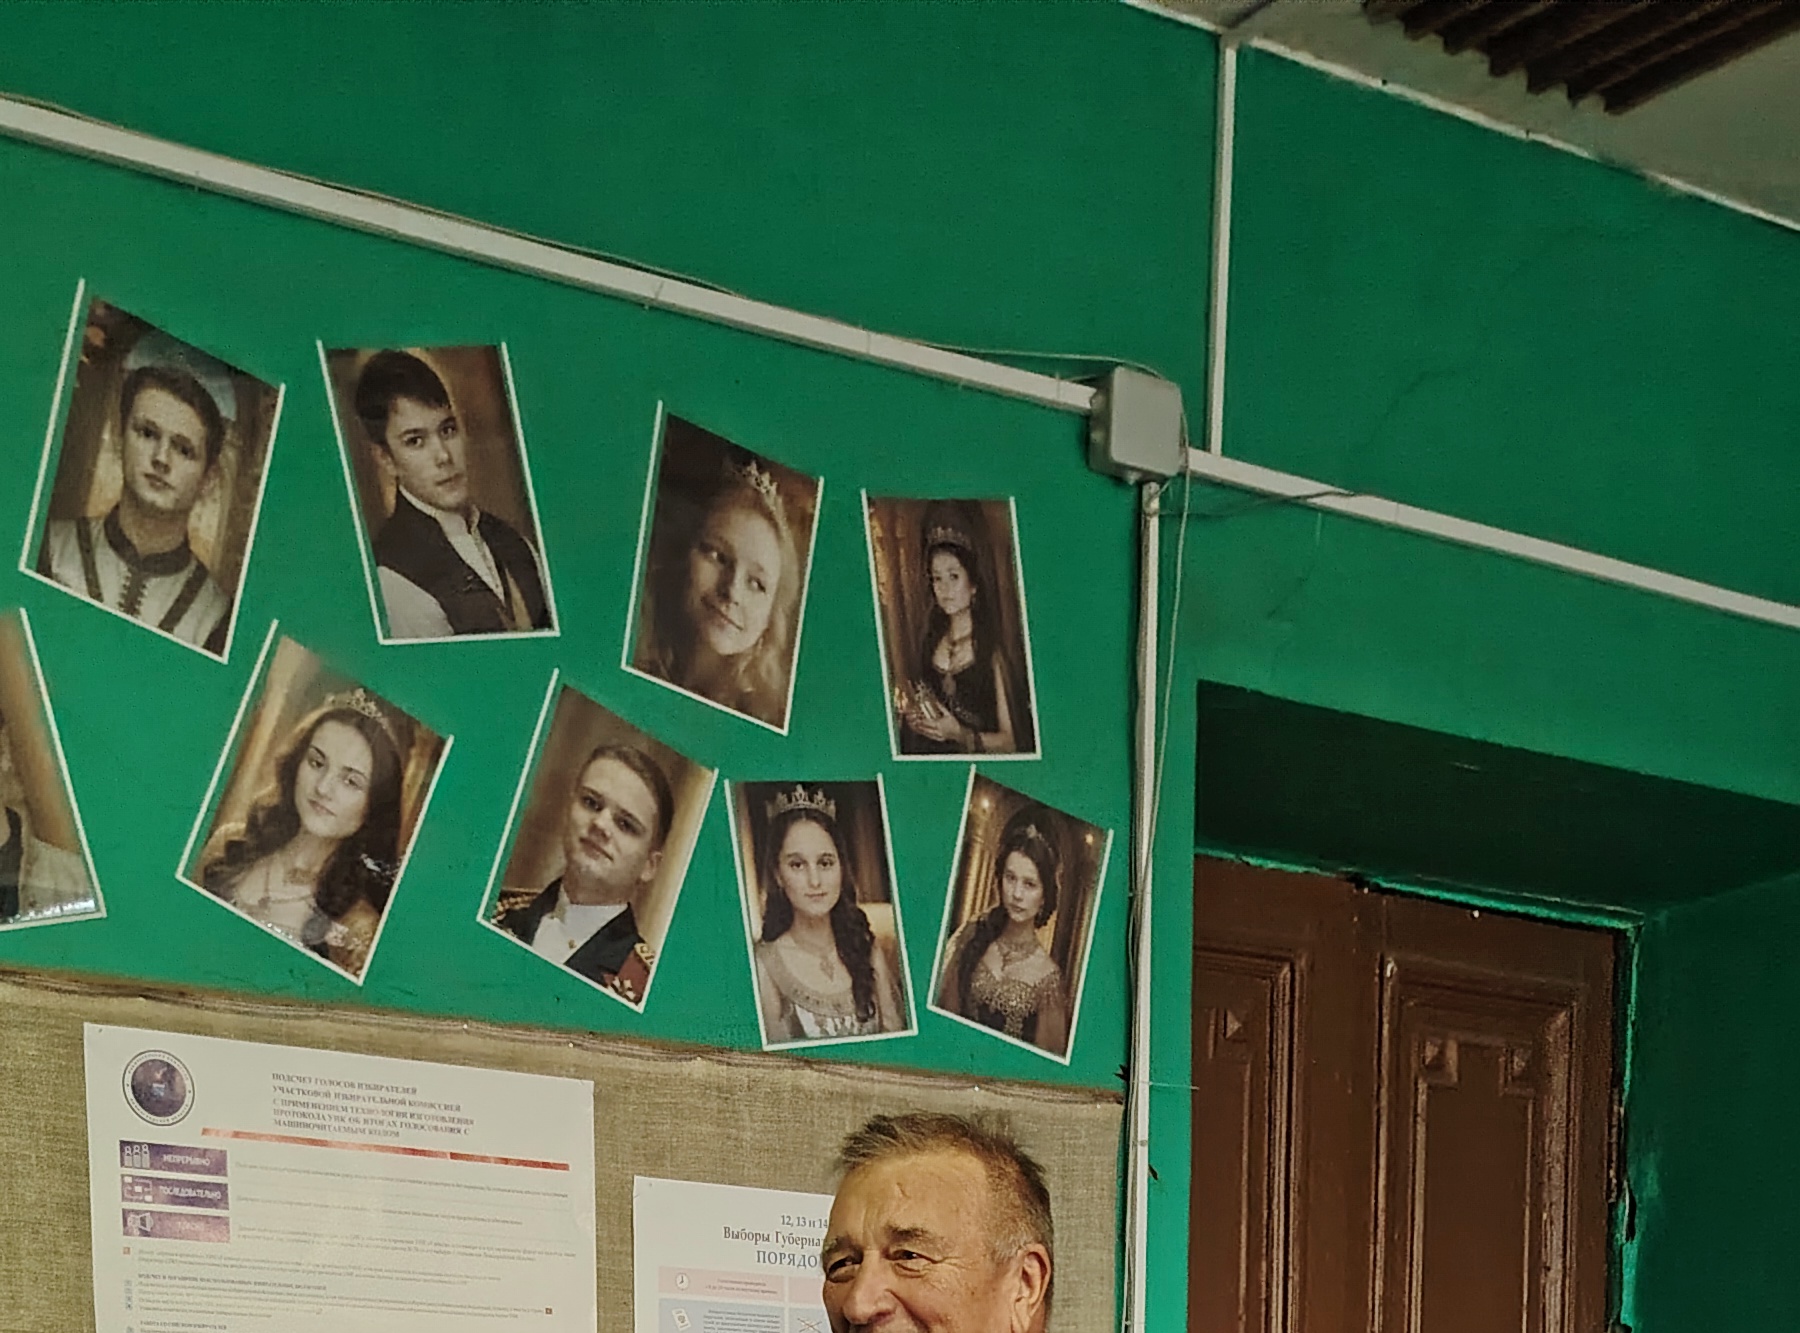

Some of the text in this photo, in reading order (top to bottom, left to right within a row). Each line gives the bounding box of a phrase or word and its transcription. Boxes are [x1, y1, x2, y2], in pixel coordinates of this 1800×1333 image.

[315, 1077, 355, 1089] ГОЛОСОВ
[272, 1085, 332, 1099] УЧАСТКОВОЙ
[781, 1215, 794, 1227] 12,
[796, 1216, 807, 1227] 13
[808, 1220, 816, 1228] и
[723, 1226, 823, 1249] Выборы Губерна
